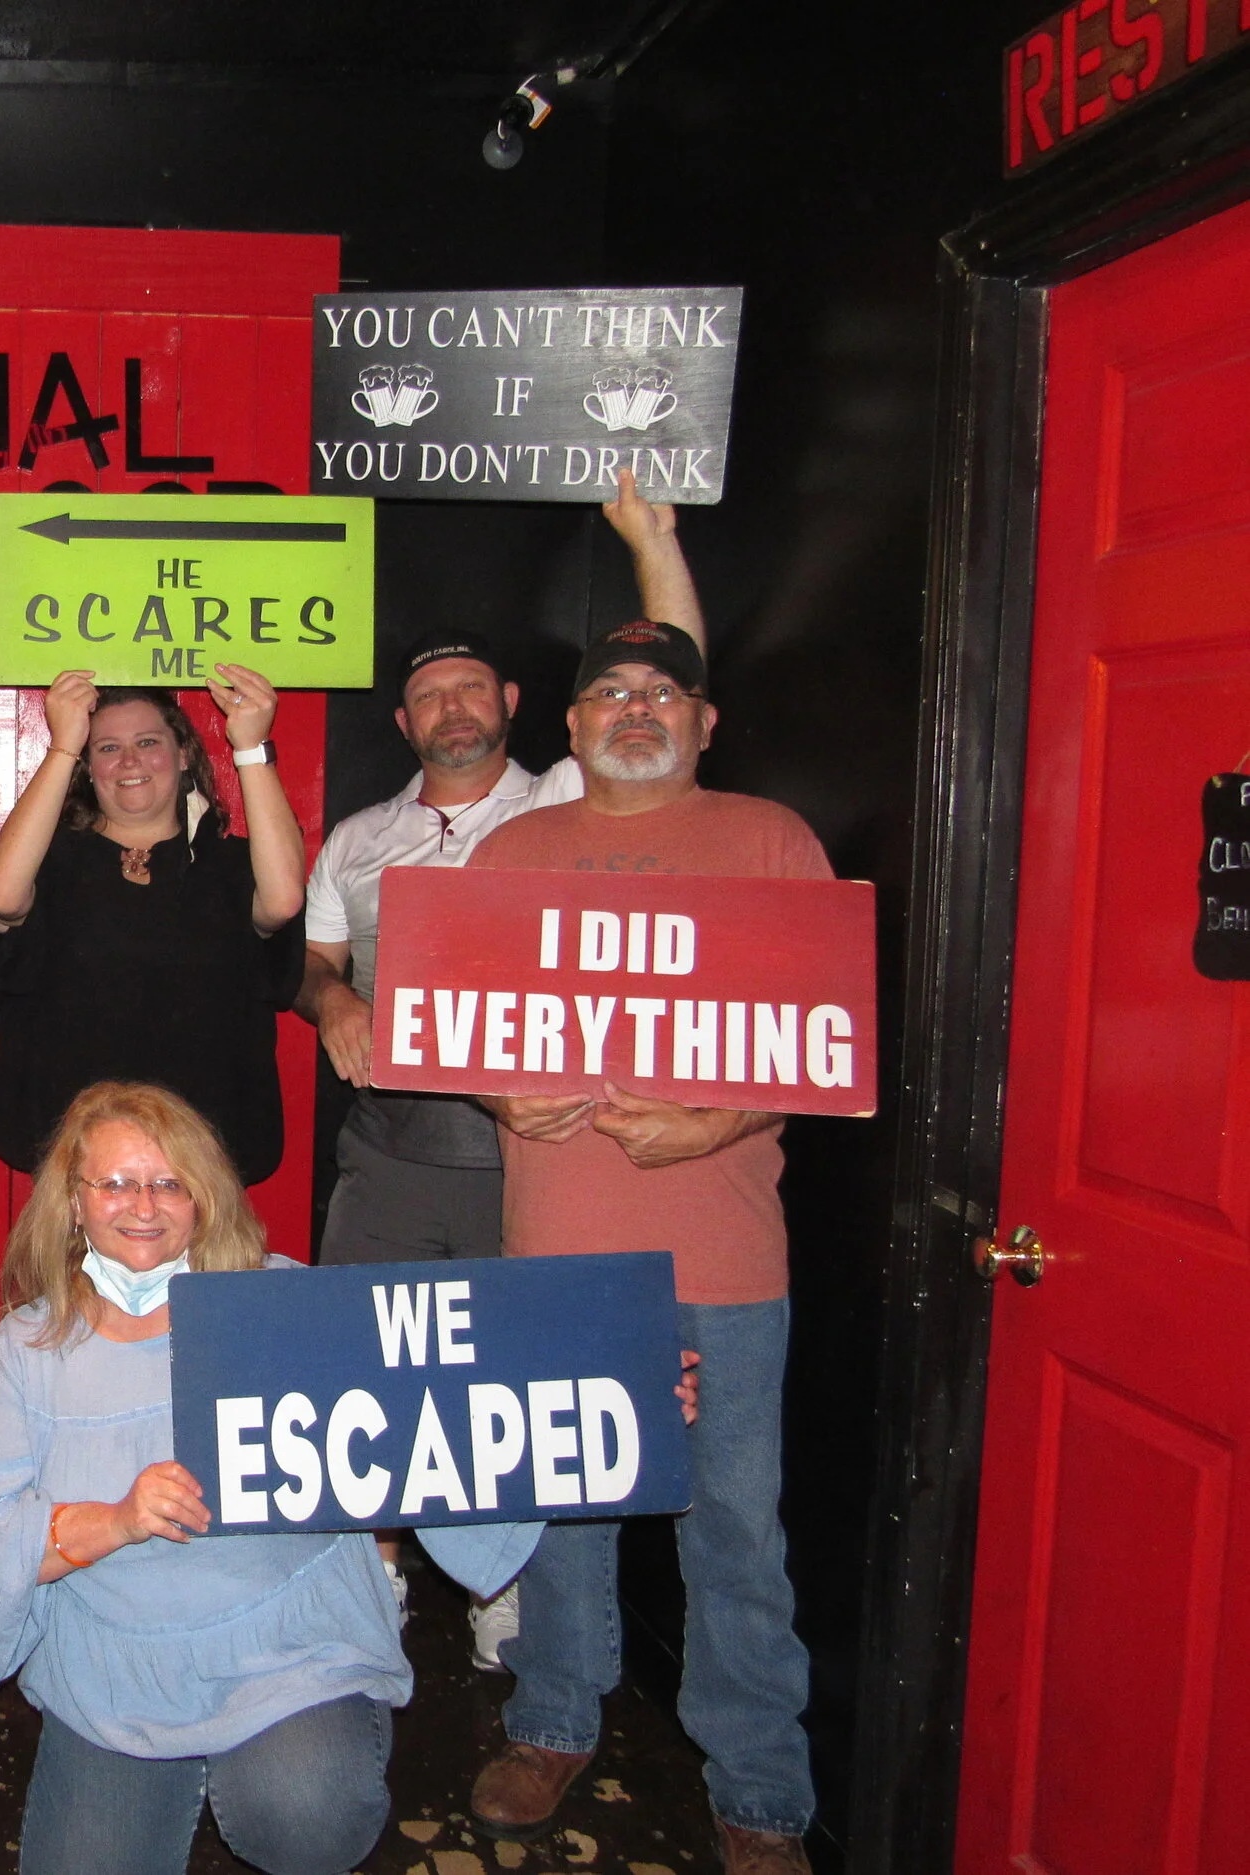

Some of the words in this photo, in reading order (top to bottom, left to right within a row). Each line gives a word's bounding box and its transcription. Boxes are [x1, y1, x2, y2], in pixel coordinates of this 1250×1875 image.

[1008, 0, 1250, 168] RES
[322, 307, 416, 349] YOU
[427, 306, 563, 349] CAN'T
[576, 306, 727, 349] THINK
[492, 377, 534, 417] IF
[315, 442, 406, 482] YOU
[417, 443, 550, 486] DON'T
[560, 446, 713, 489] DRINK
[157, 558, 203, 589] HE
[23, 592, 337, 644] SCARES
[151, 647, 207, 678] ME
[539, 908, 560, 969] I
[579, 910, 696, 975] DID
[391, 987, 854, 1088] EVERYTHING
[372, 1280, 476, 1368] WE
[216, 1377, 640, 1524] ESCAPED
